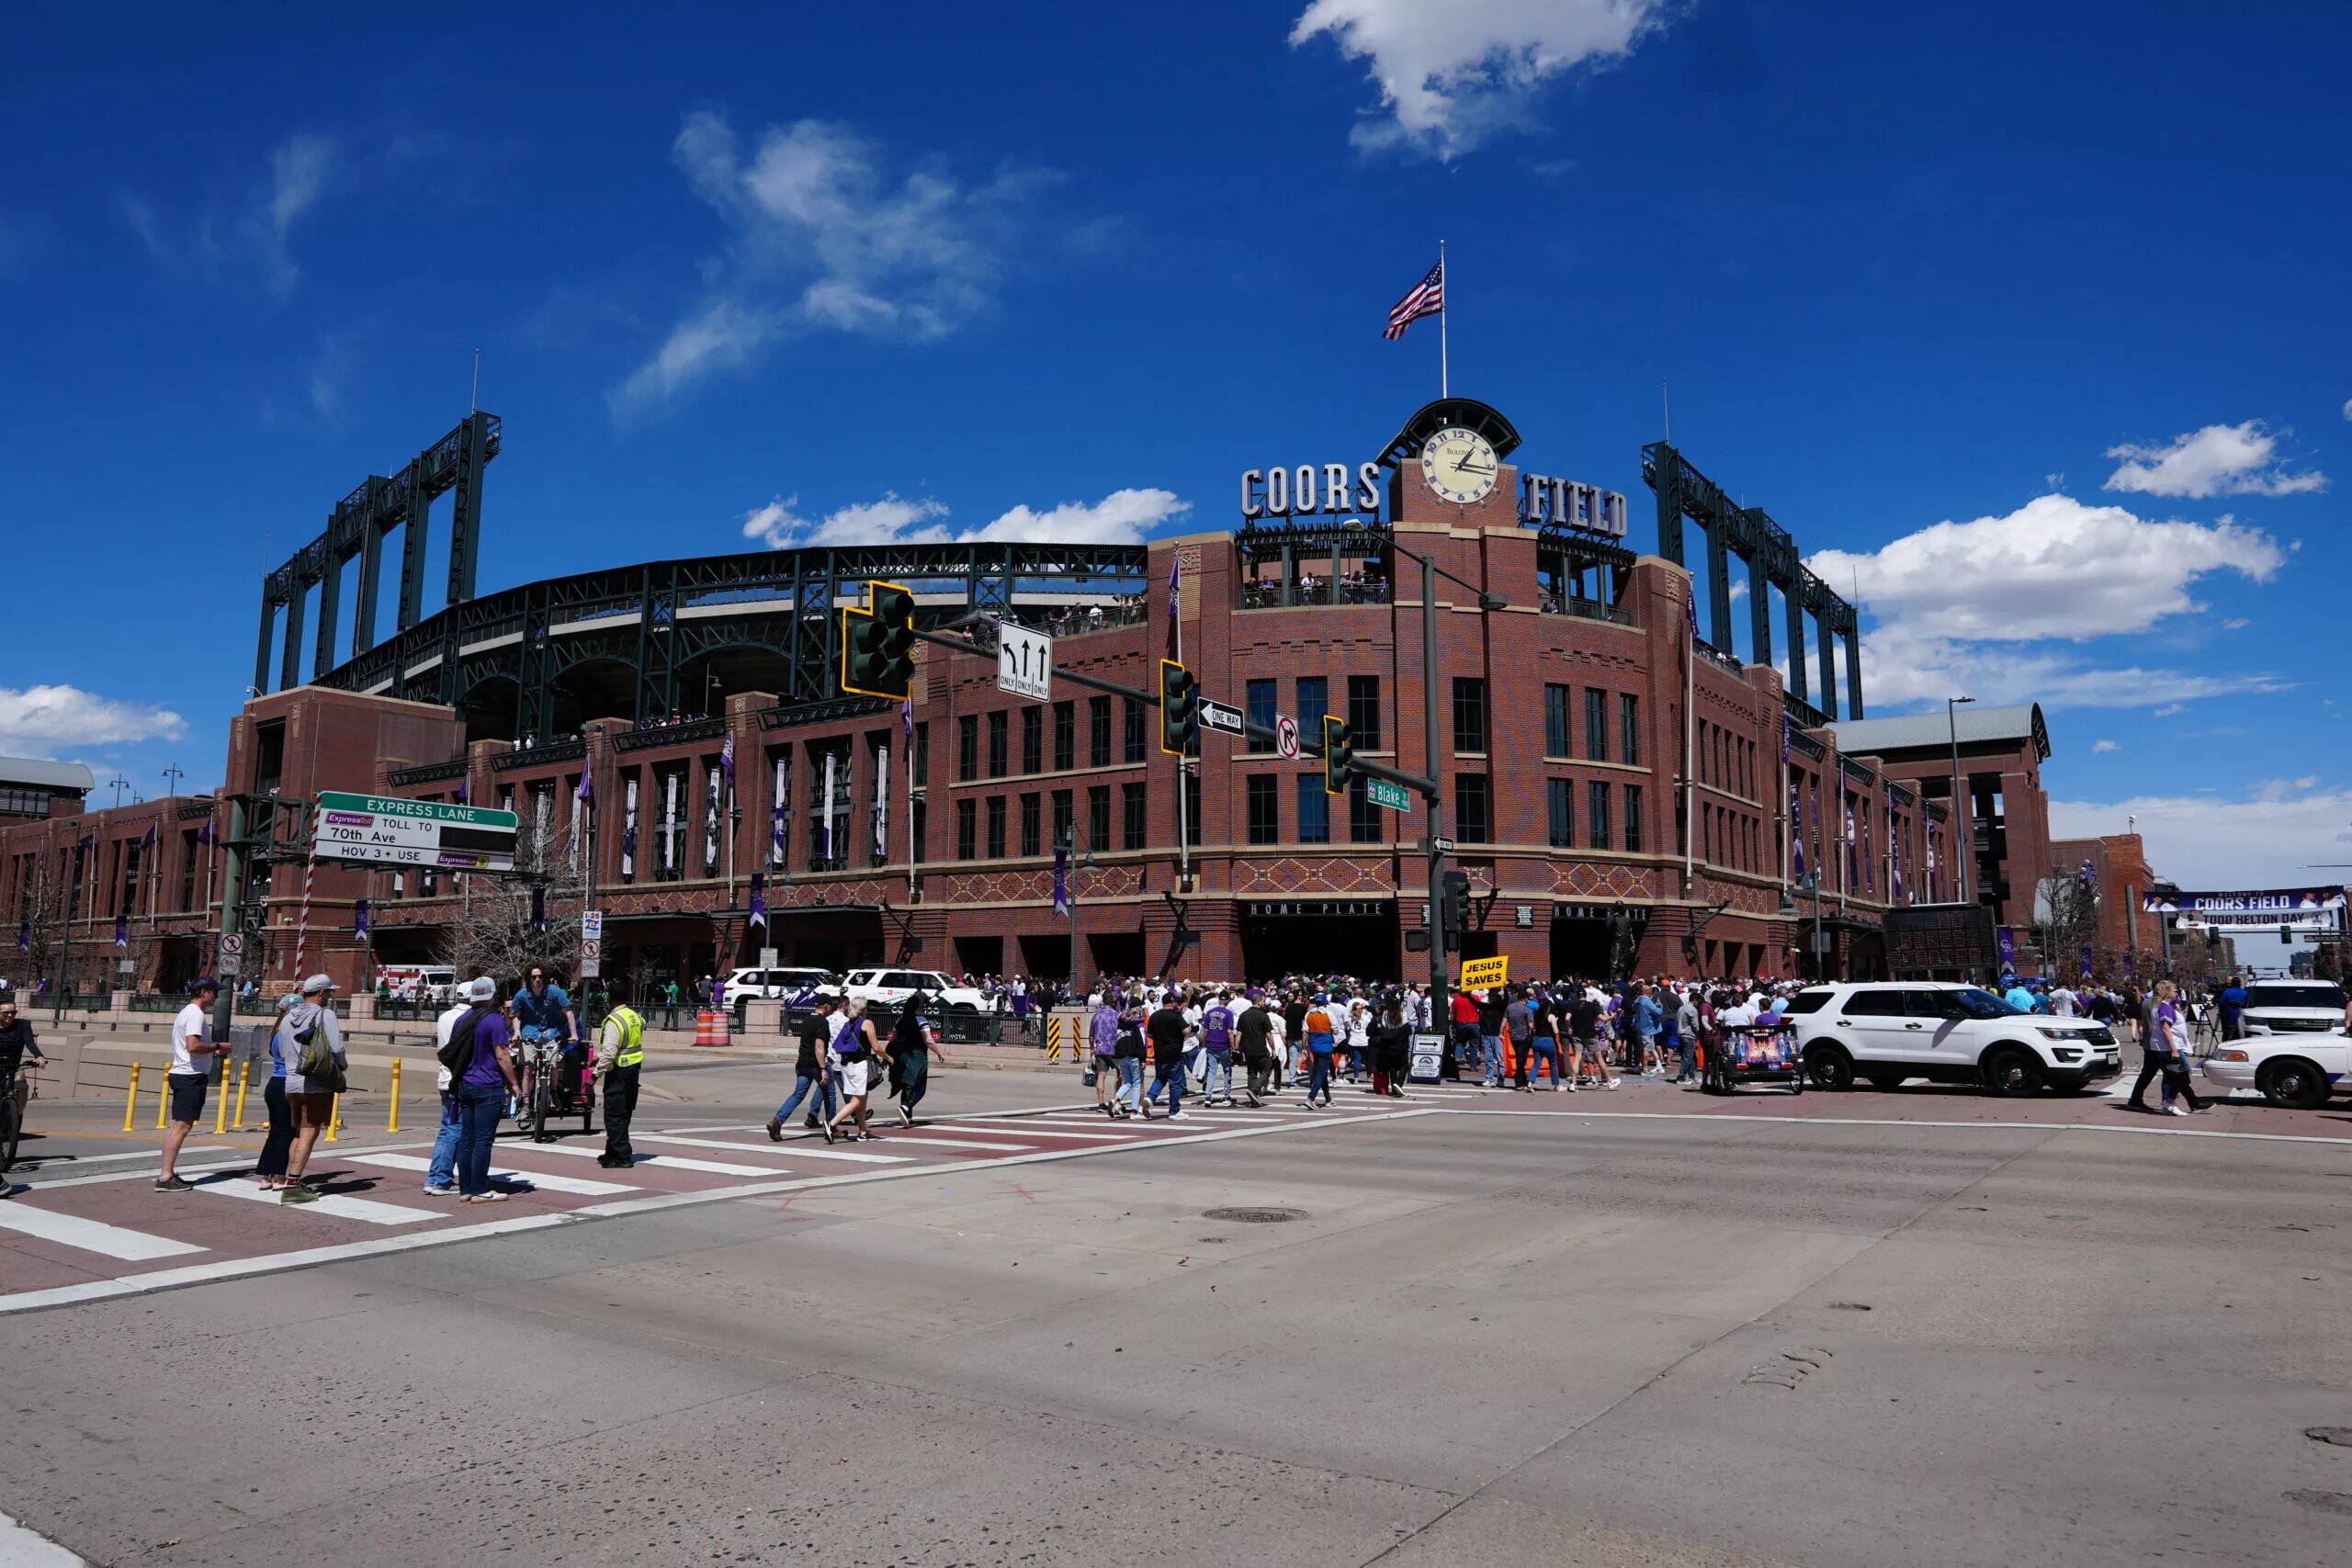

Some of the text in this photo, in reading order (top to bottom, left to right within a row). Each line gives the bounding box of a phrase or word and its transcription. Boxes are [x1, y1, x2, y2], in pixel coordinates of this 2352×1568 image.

[1437, 433, 1447, 442] 11
[1427, 443, 1437, 454] 10
[1482, 447, 1490, 456] 2
[1484, 479, 1492, 488] 4
[1242, 462, 1627, 535] COORS FIELD
[1473, 490, 1481, 498] 5
[1000, 675, 1047, 696] ONLY ONLY ONLY
[1212, 710, 1239, 727] ONE WAY
[1378, 785, 1400, 806] Blake
[367, 798, 476, 821] EXPRESS LANE
[382, 818, 411, 830] TOLL
[419, 822, 432, 832] TO
[330, 827, 396, 843] 70th Ave
[342, 846, 367, 857] HOV
[398, 850, 421, 861] USE
[1251, 903, 1381, 915] HOME PLATE
[2195, 896, 2290, 910] COORS FIELD
[1555, 907, 1594, 918] HOME
[2203, 913, 2304, 925] TODD HELTON DAY
[1465, 960, 1503, 974] JESUS
[1465, 973, 1501, 987] SAVES
[1420, 1007, 1429, 1017] 19
[1208, 1017, 1224, 1031] 24
[1353, 1021, 1362, 1030] 19
